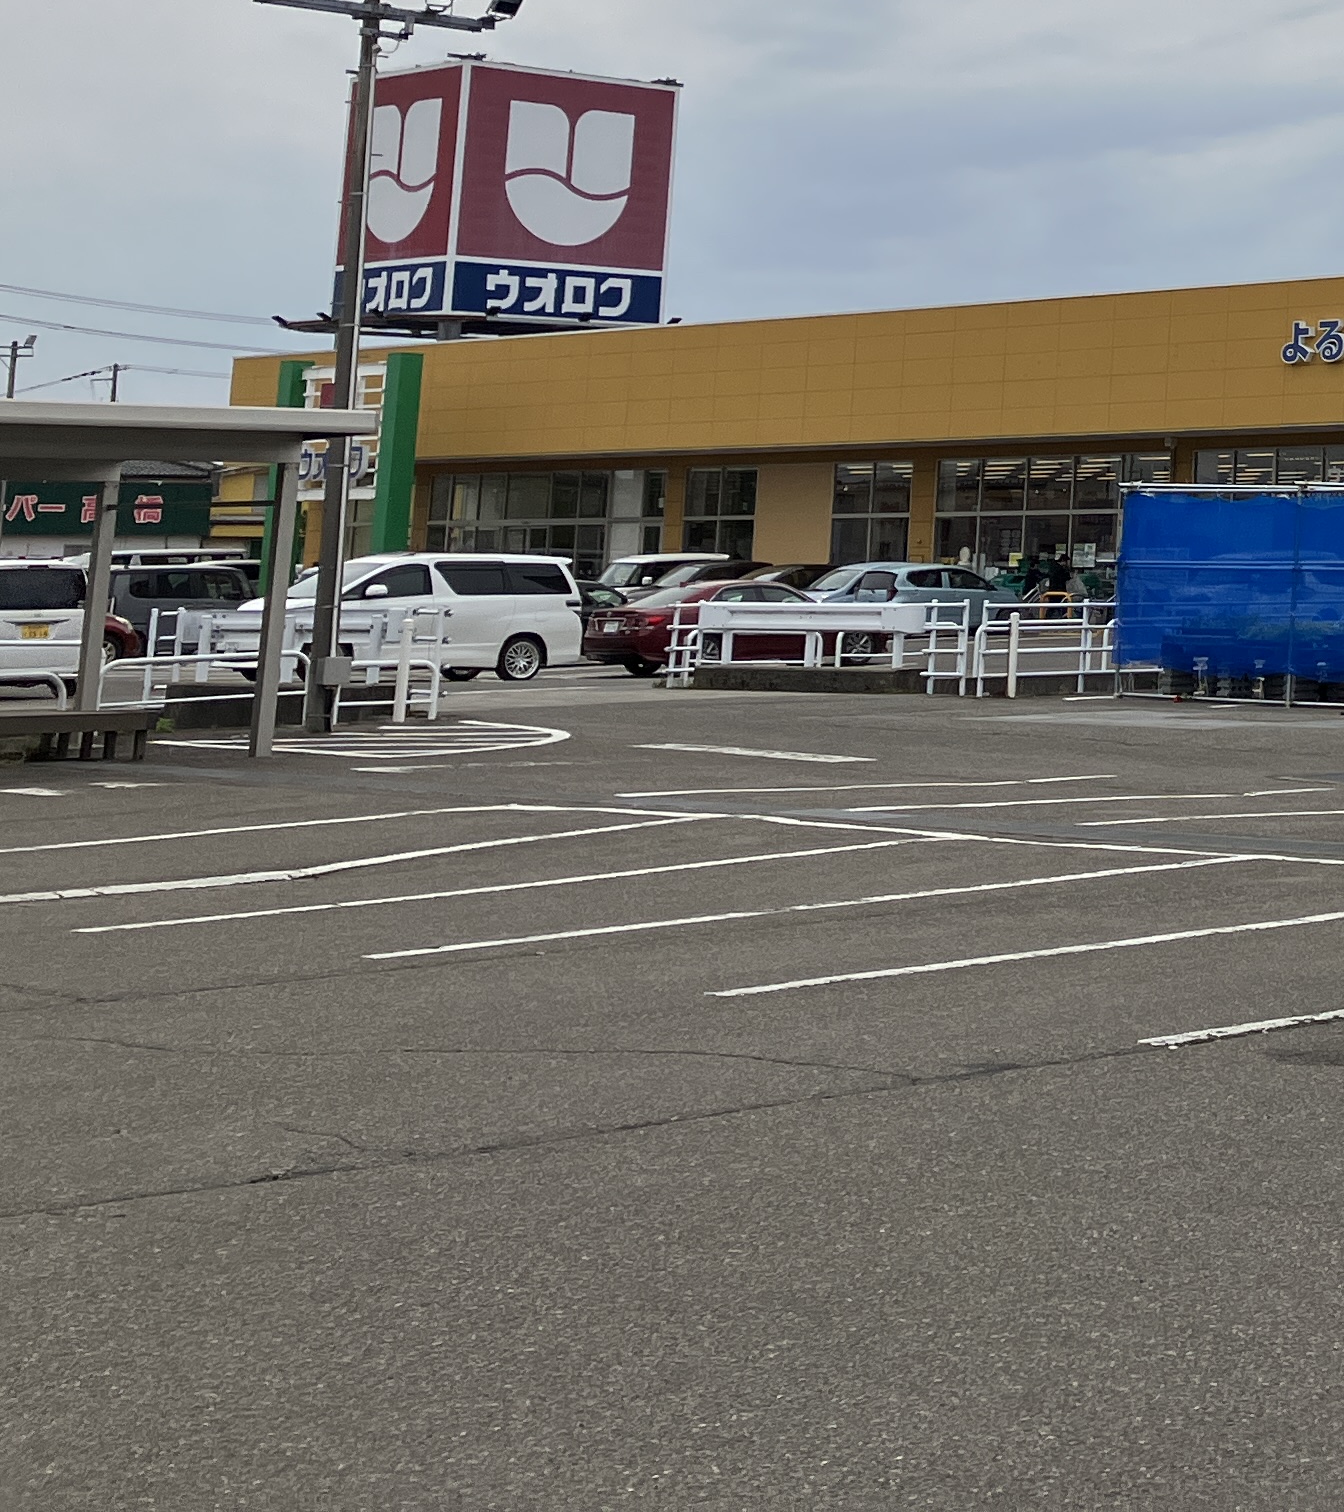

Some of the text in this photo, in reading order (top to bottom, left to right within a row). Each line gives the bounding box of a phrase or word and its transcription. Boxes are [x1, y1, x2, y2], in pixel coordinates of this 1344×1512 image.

[363, 266, 434, 313] オロク
[485, 269, 633, 318] ウオロク
[298, 447, 363, 480] ウオク
